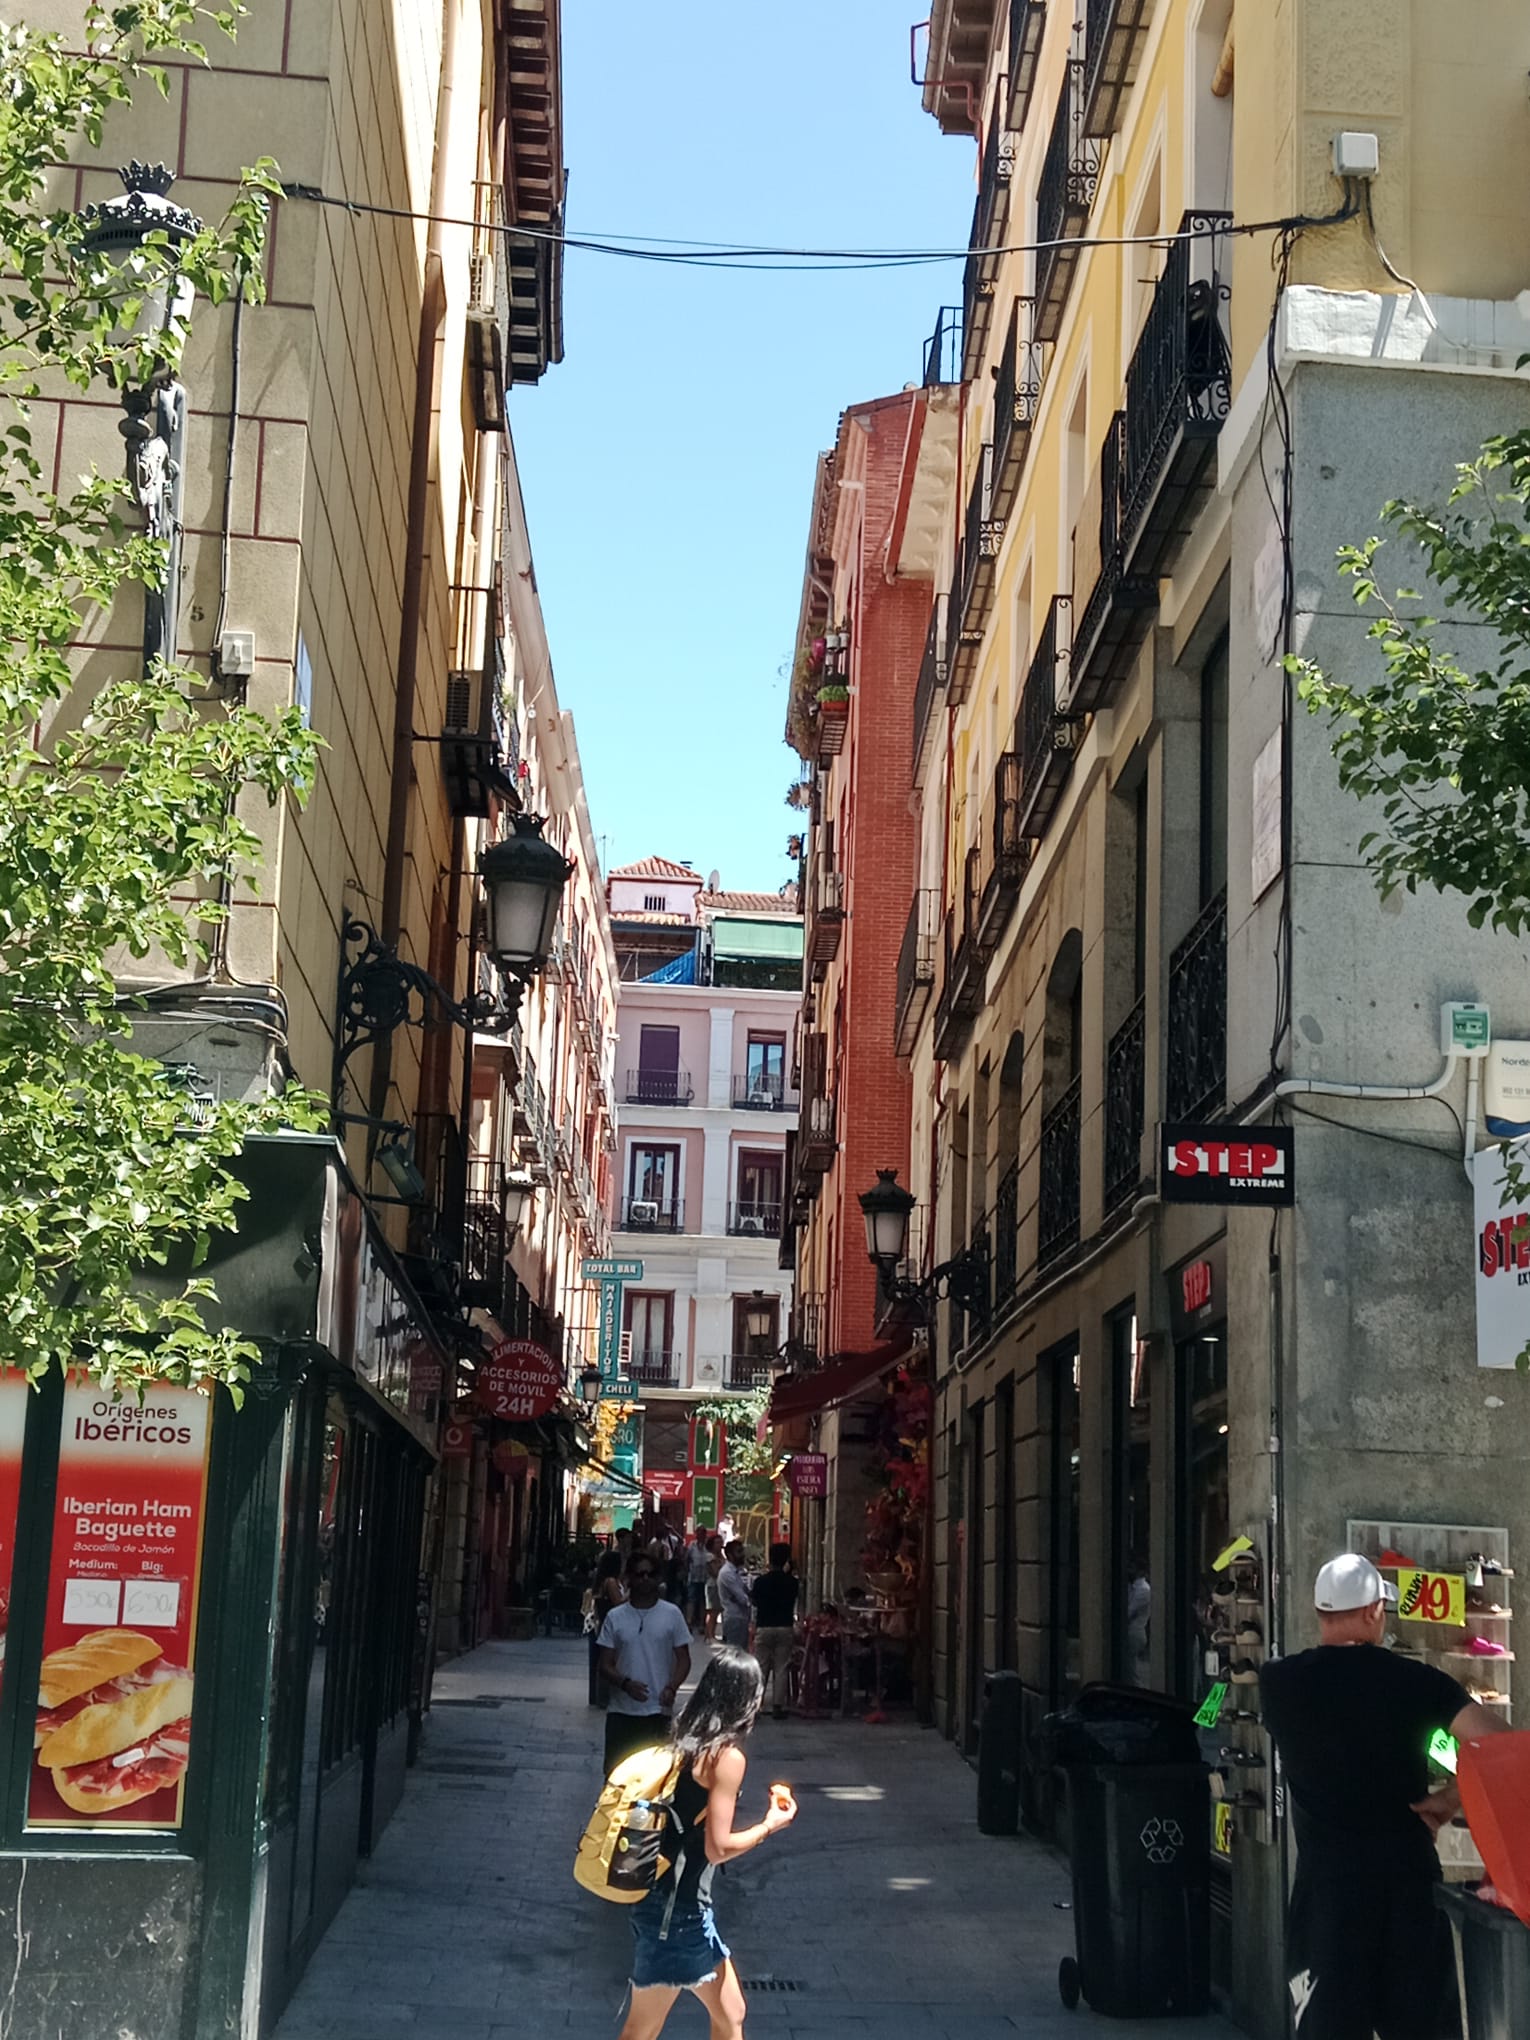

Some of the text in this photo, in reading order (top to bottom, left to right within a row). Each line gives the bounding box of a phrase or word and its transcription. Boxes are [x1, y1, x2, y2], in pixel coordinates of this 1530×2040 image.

[1174, 1140, 1278, 1177] STEP
[1229, 1178, 1285, 1188] EXTREME
[586, 1264, 614, 1274] TOTAL
[603, 1284, 615, 1375] MAJADERITOS
[518, 1358, 525, 1367] Y
[480, 1366, 558, 1385] ACCESORIOS
[489, 1381, 505, 1392] DE
[496, 1395, 534, 1416] 24H
[75, 1417, 191, 1444] Ibéricos
[63, 1497, 192, 1518] Iberian Ham
[75, 1518, 176, 1541] Baguette
[122, 1543, 136, 1553] de
[138, 1543, 174, 1554] Jamón
[69, 1559, 164, 1574] Medium: Big:
